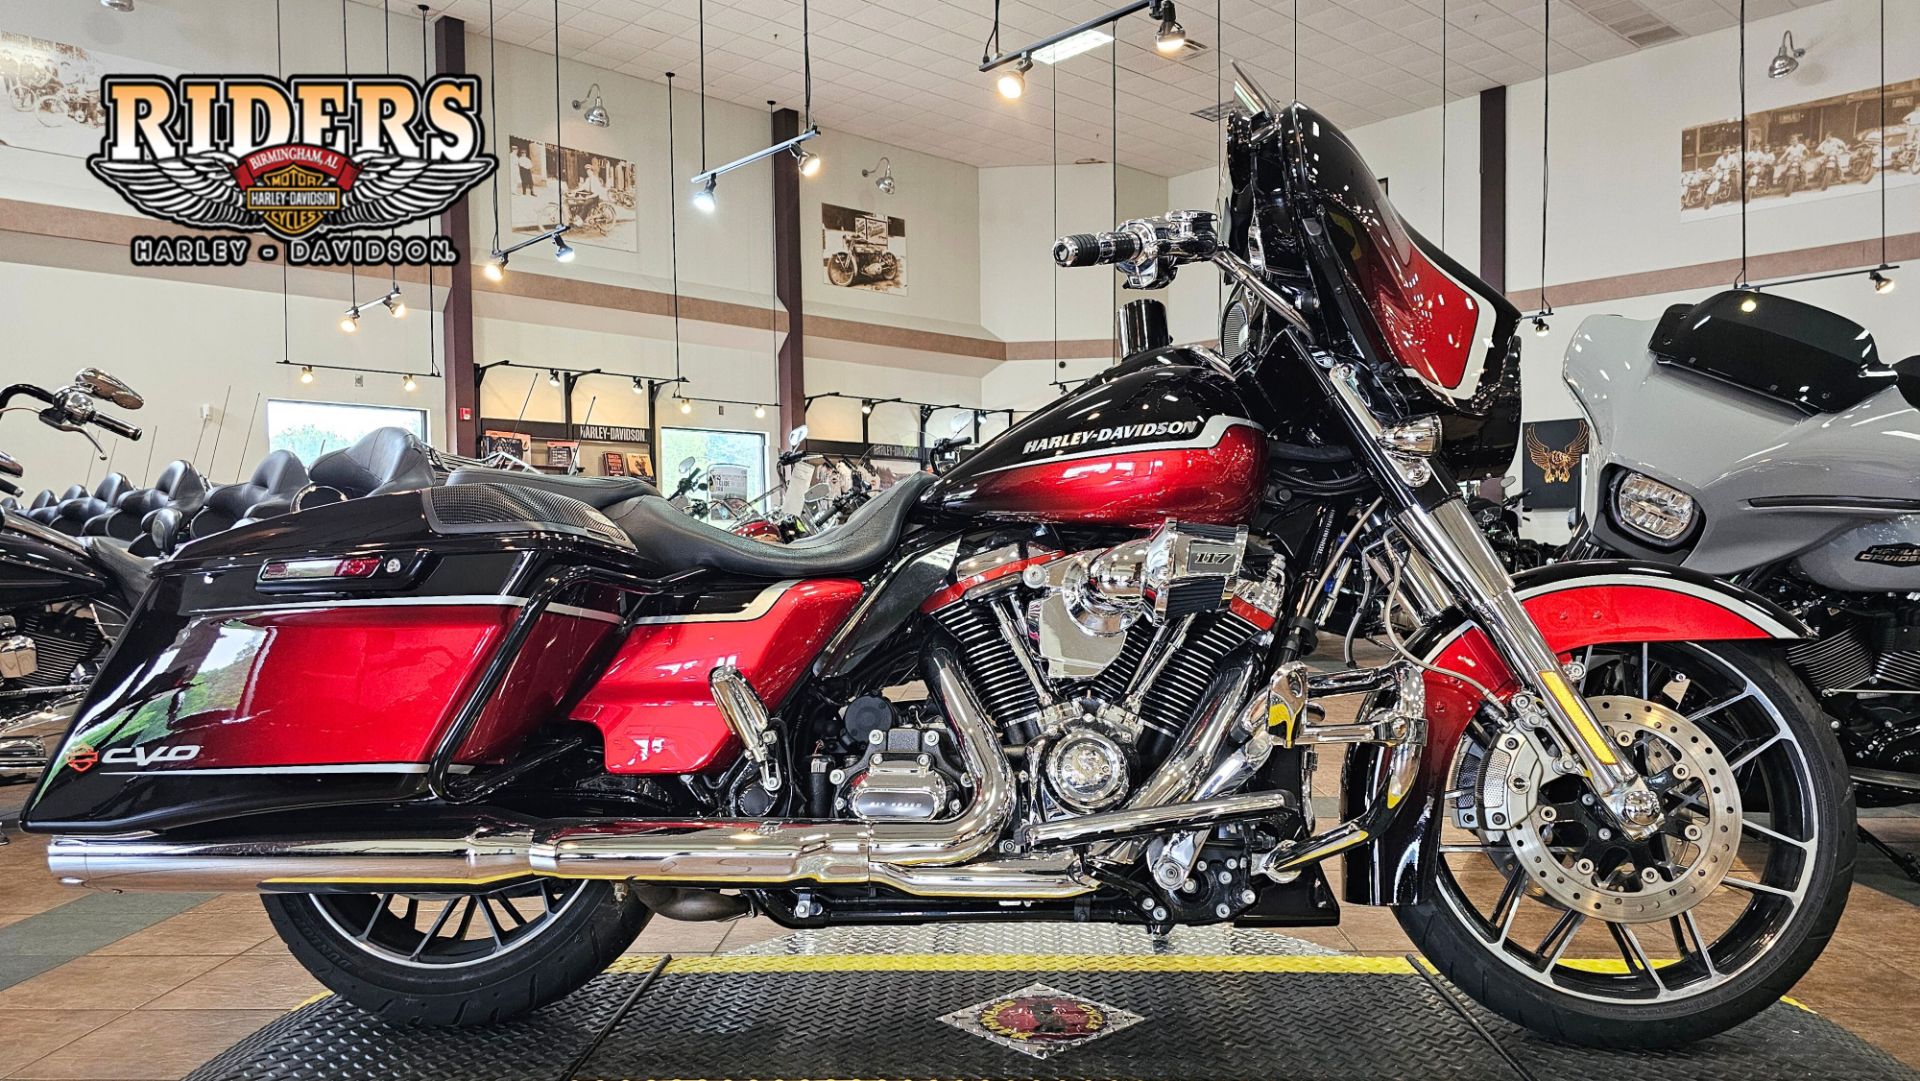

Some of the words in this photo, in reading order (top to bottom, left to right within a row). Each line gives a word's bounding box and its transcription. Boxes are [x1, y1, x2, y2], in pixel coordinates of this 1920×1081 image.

[580, 425, 646, 442] HARLEY-DAVIDSON
[1022, 420, 1197, 454] HARLEY-DAVIDSON
[1195, 551, 1233, 565] 117
[1859, 553, 1920, 562] DAVIDS
[101, 744, 202, 766] CVO
